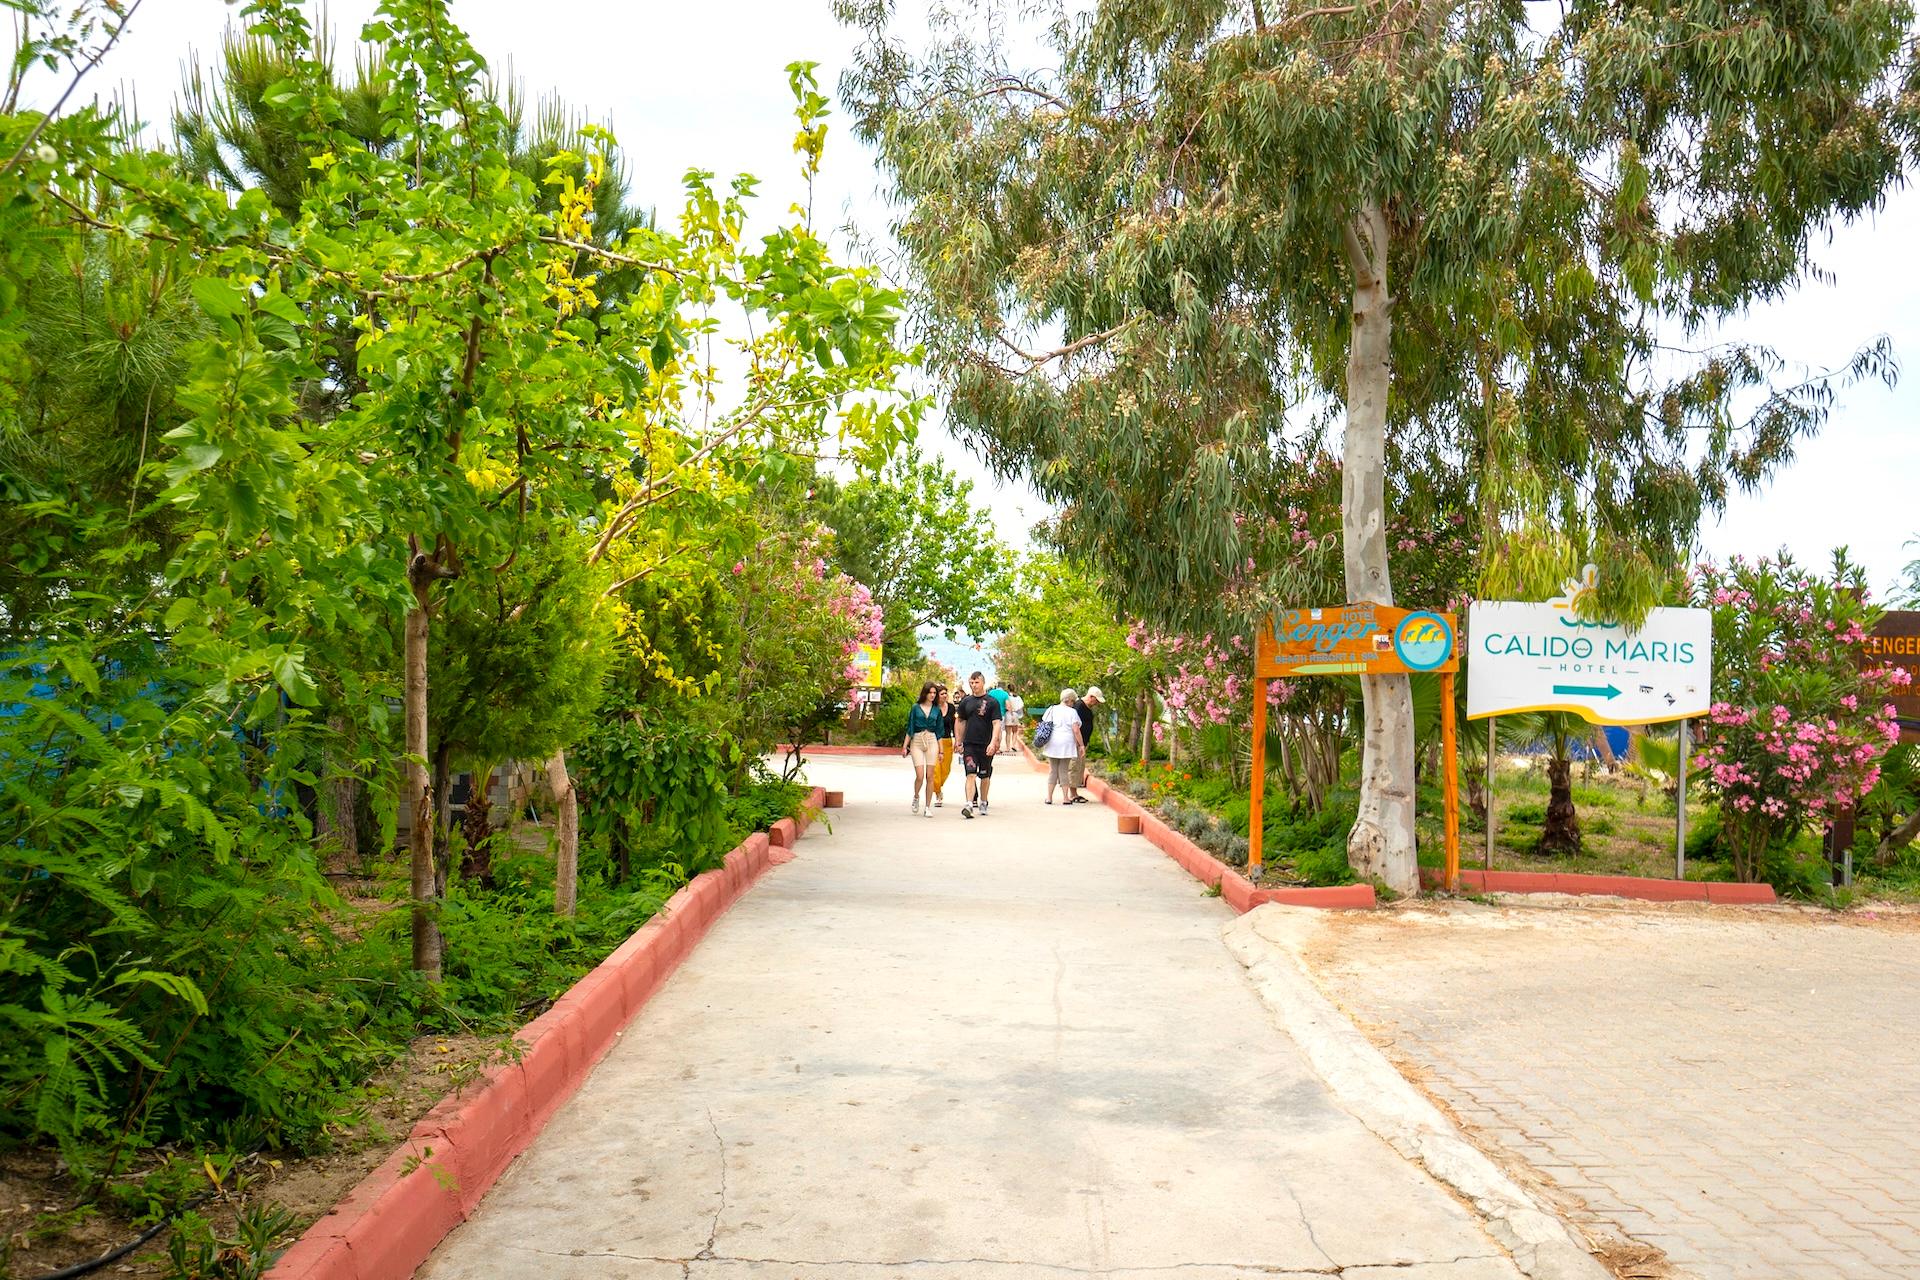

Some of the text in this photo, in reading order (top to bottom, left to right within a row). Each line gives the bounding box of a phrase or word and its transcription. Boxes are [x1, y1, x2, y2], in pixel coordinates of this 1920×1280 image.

[1485, 634, 1694, 664] CALIDO MARIS
[1560, 663, 1618, 674] HOTEL
